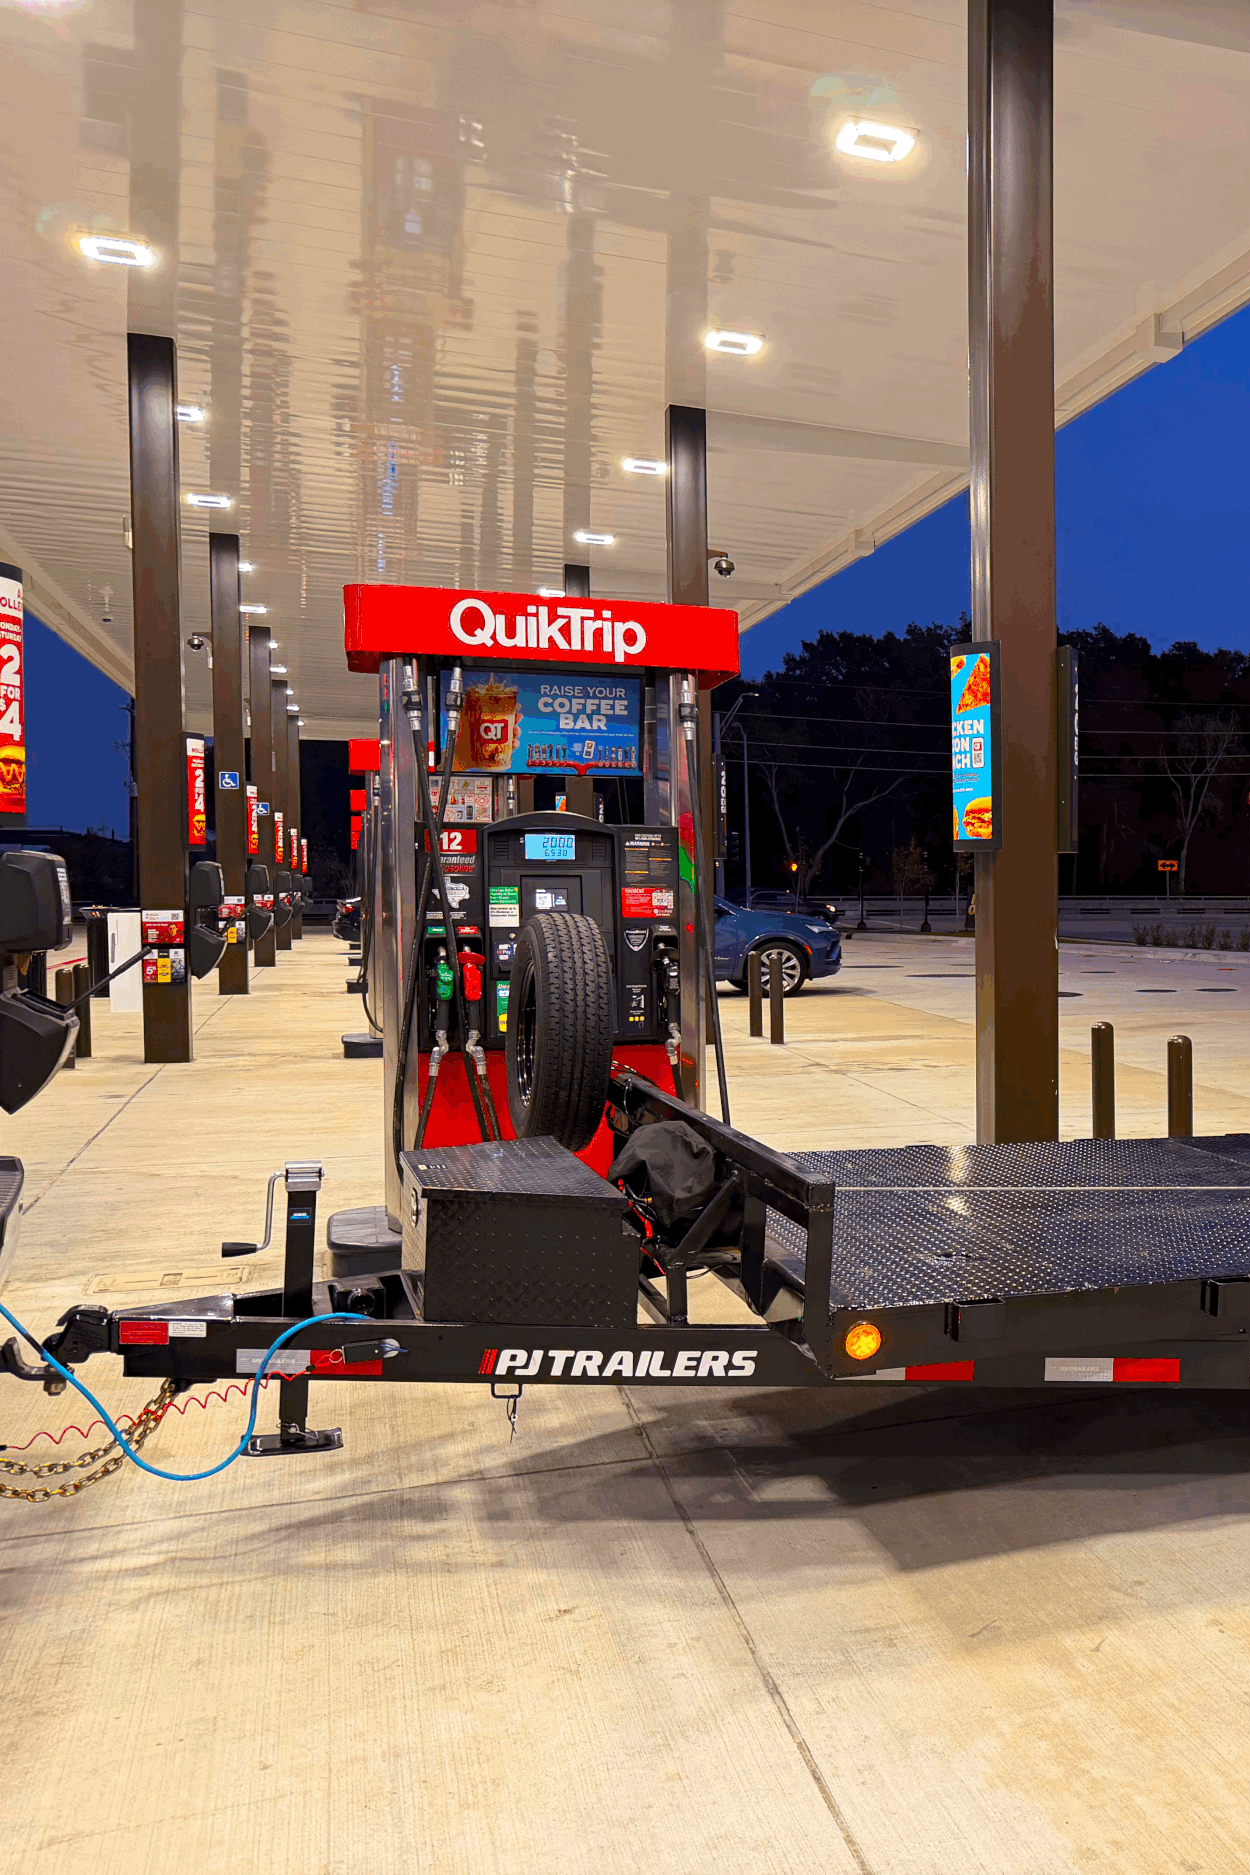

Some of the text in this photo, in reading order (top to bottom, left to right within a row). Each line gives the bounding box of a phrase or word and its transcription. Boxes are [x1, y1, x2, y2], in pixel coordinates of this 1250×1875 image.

[449, 597, 647, 663] QuikTrip
[0, 643, 21, 687] 2
[0, 685, 21, 700] FOR
[540, 684, 626, 698] RAISE YOUR
[537, 696, 629, 716] COFFEE
[480, 722, 505, 741] QT
[559, 713, 608, 731] BAR
[440, 831, 463, 851] 12
[494, 1348, 759, 1378] PJ TRAILERS
